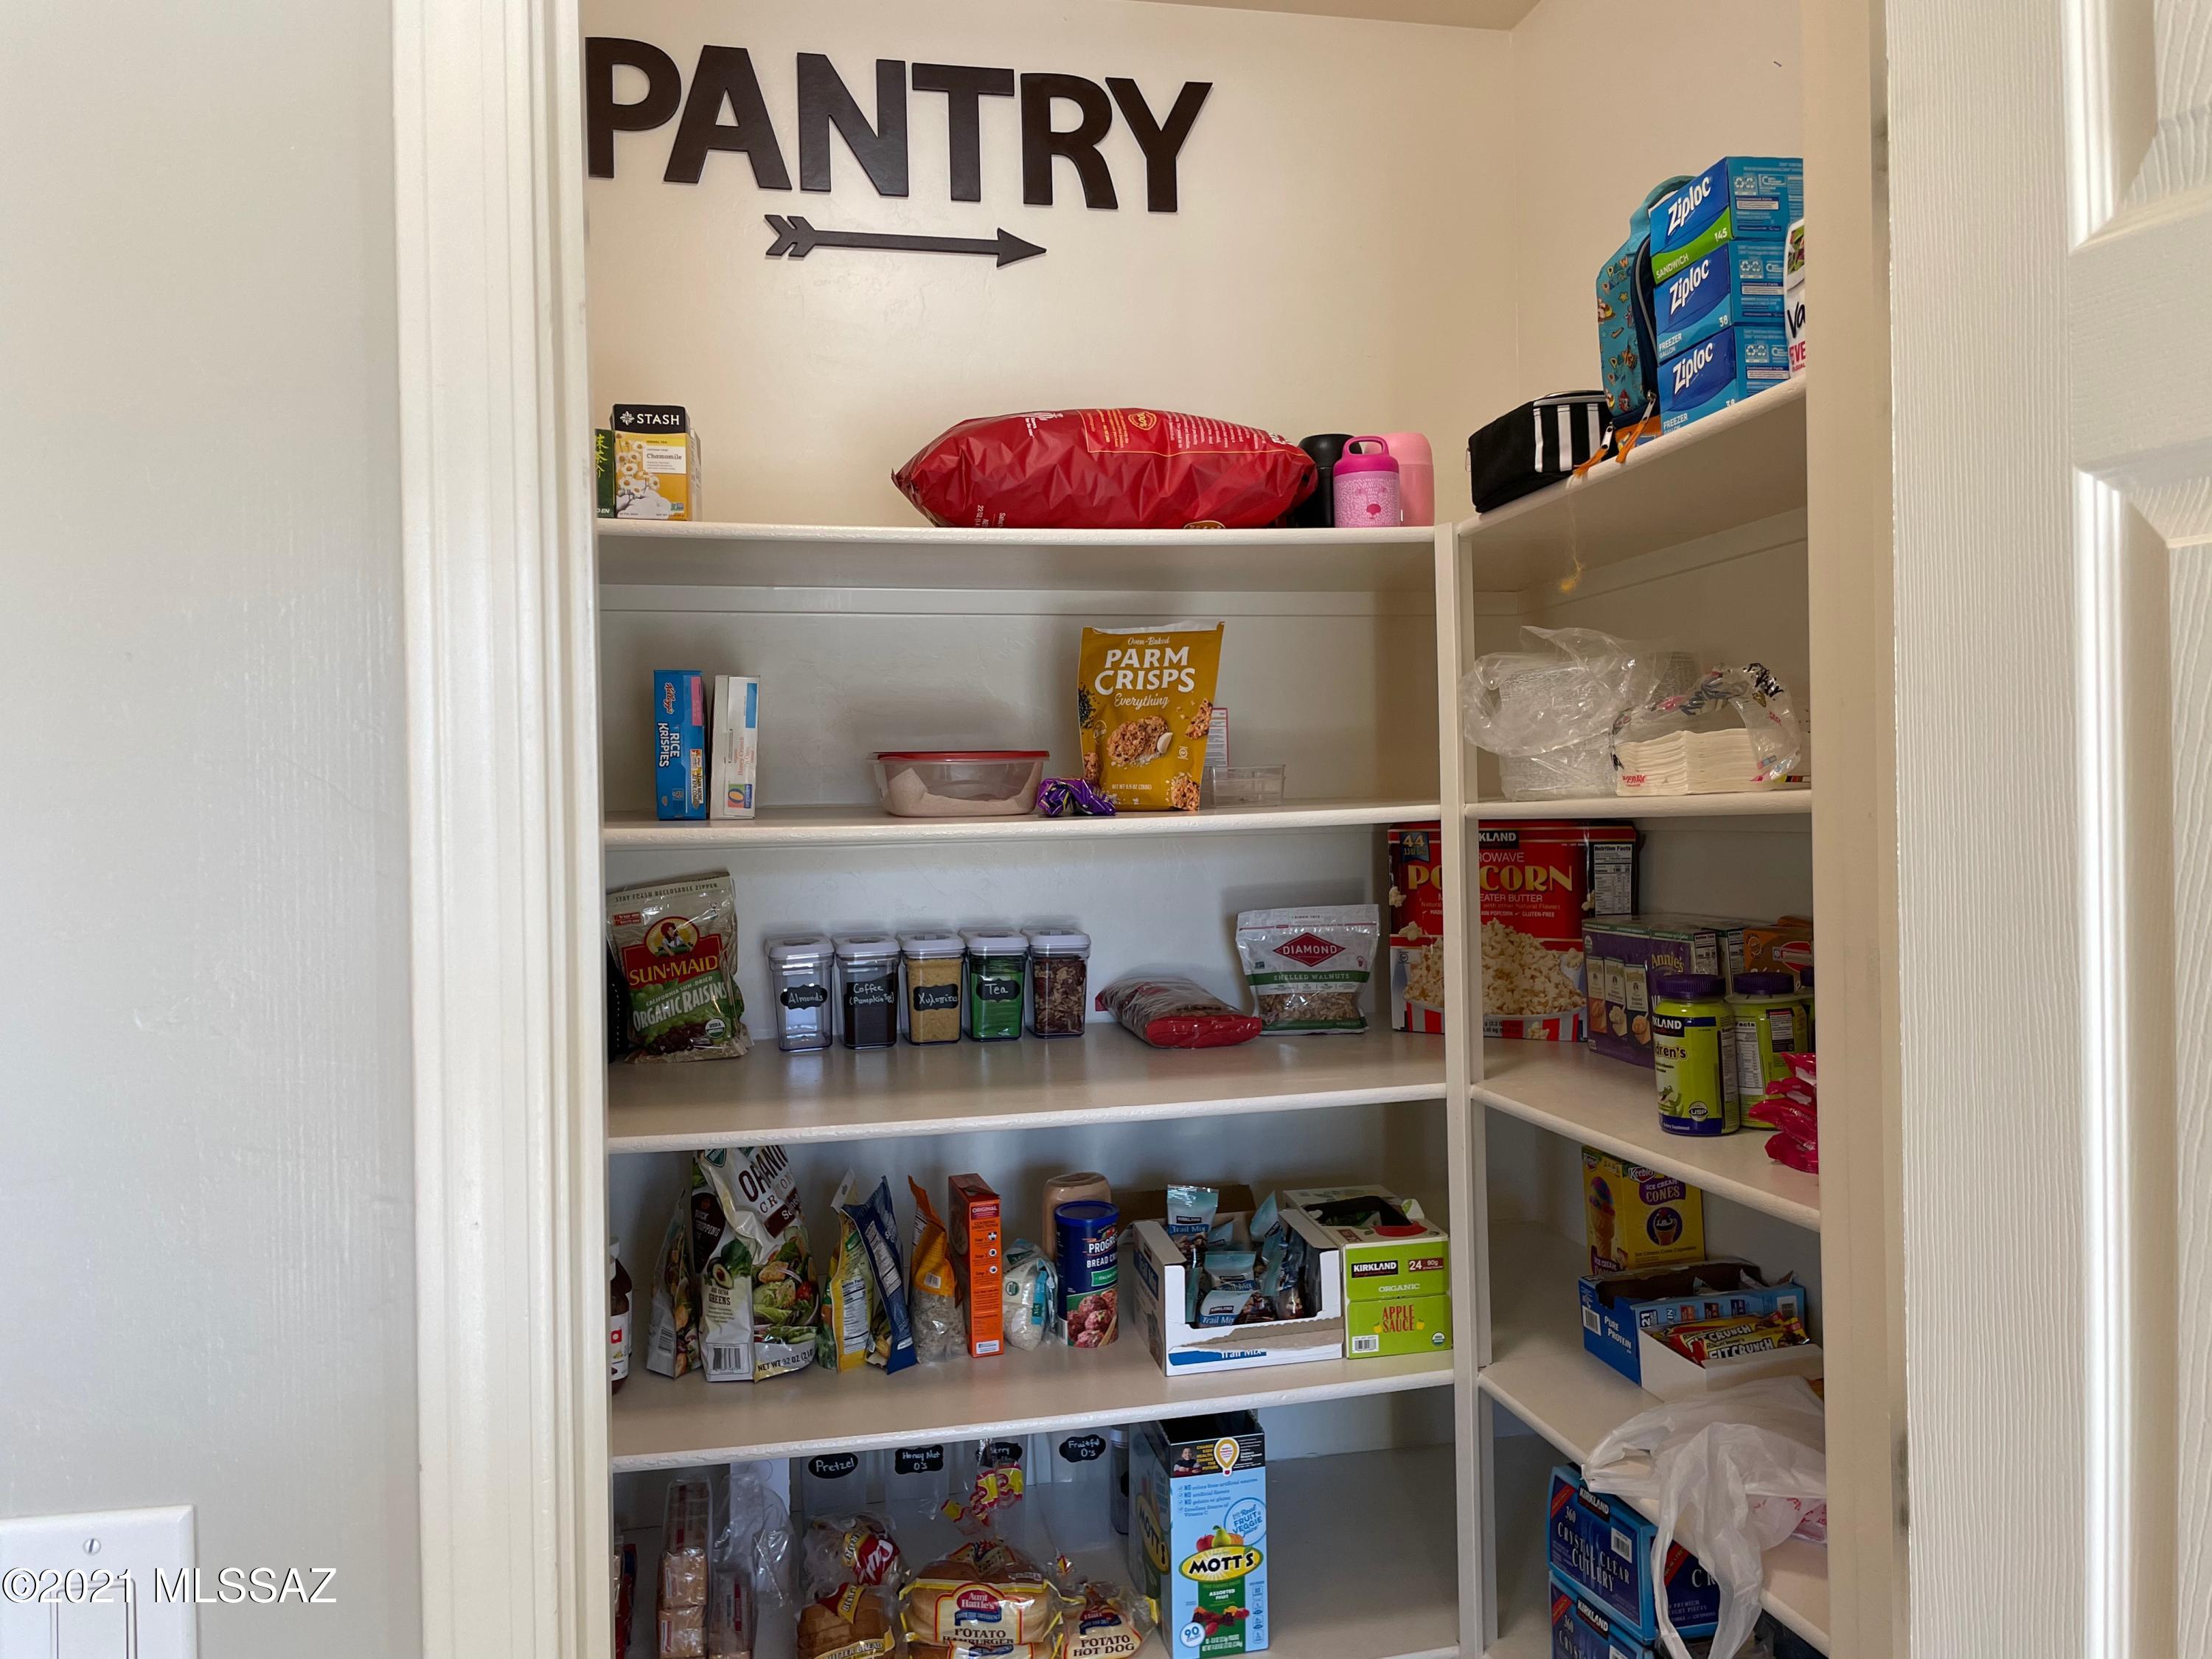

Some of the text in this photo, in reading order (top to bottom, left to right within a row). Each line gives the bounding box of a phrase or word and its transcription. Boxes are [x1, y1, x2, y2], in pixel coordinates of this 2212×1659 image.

[585, 37, 1213, 212] PANTRY
[1668, 177, 1711, 236] Ziploc
[1714, 228, 1728, 242] 145
[1656, 253, 1689, 279] SANDWICH
[1669, 259, 1710, 316] Ziploc
[1659, 333, 1682, 352] FREEZER
[1672, 342, 1714, 394] Ziploc
[636, 413, 680, 425] STASH
[1663, 413, 1688, 429] FREEZER
[1127, 636, 1171, 646] Oven-Baked
[1104, 646, 1190, 669] PARM
[1094, 667, 1195, 695] CRISPS
[1114, 692, 1169, 710] Everything
[658, 723, 669, 768] KRISPIES
[669, 732, 681, 758] RICE
[1402, 834, 1425, 847] 44
[1509, 894, 1543, 902] BUTTER
[1282, 945, 1338, 955] DIAMOND
[1652, 951, 1685, 973] Annie's
[1273, 973, 1310, 981] SHELLED
[853, 983, 884, 994] Coffee
[984, 983, 1009, 995] Tea
[646, 989, 680, 1006] CALIFORNIA
[787, 992, 824, 1004] Almonds
[633, 981, 727, 1032] ORGANIC RAISINS
[1629, 1167, 1656, 1180] Keebler
[1646, 1186, 1680, 1203] CONES
[972, 1206, 998, 1214] ORIGINAL
[1172, 1225, 1189, 1234] Trail
[1086, 1256, 1109, 1268] BREAD
[1354, 1262, 1397, 1273] KIRKLAND
[1409, 1260, 1422, 1270] 24
[1378, 1283, 1421, 1293] ORGANIC
[709, 1293, 731, 1306] GREENS
[1382, 1304, 1415, 1320] APPLE
[1641, 1312, 1650, 1326] 21
[1202, 1316, 1219, 1324] Trail
[1382, 1316, 1415, 1333] SAUCE
[1604, 1315, 1619, 1332] PURE
[1607, 1328, 1632, 1349] PROTEIN
[757, 1363, 771, 1372] NET
[771, 1360, 781, 1368] WT
[791, 1354, 801, 1363] OZ
[902, 1450, 941, 1462] Honey Nut
[815, 1457, 855, 1472] Pretzel
[1579, 1486, 1610, 1515] KIRKLAND
[1232, 1516, 1263, 1534] VEGGIE
[1234, 1510, 1258, 1527] FRUIT
[1557, 1522, 1595, 1561] CRYSTAL
[1599, 1551, 1630, 1585] CLEAR
[1572, 1548, 1614, 1593] CUTLERY
[969, 1592, 988, 1601] Aunt
[1577, 1599, 1609, 1632] KIRKLAND
[954, 1627, 1006, 1638] POTATO
[1184, 1626, 1200, 1638] 90
[1081, 1635, 1130, 1648] POTATO
[1074, 1643, 1135, 1657] HOT DOG
